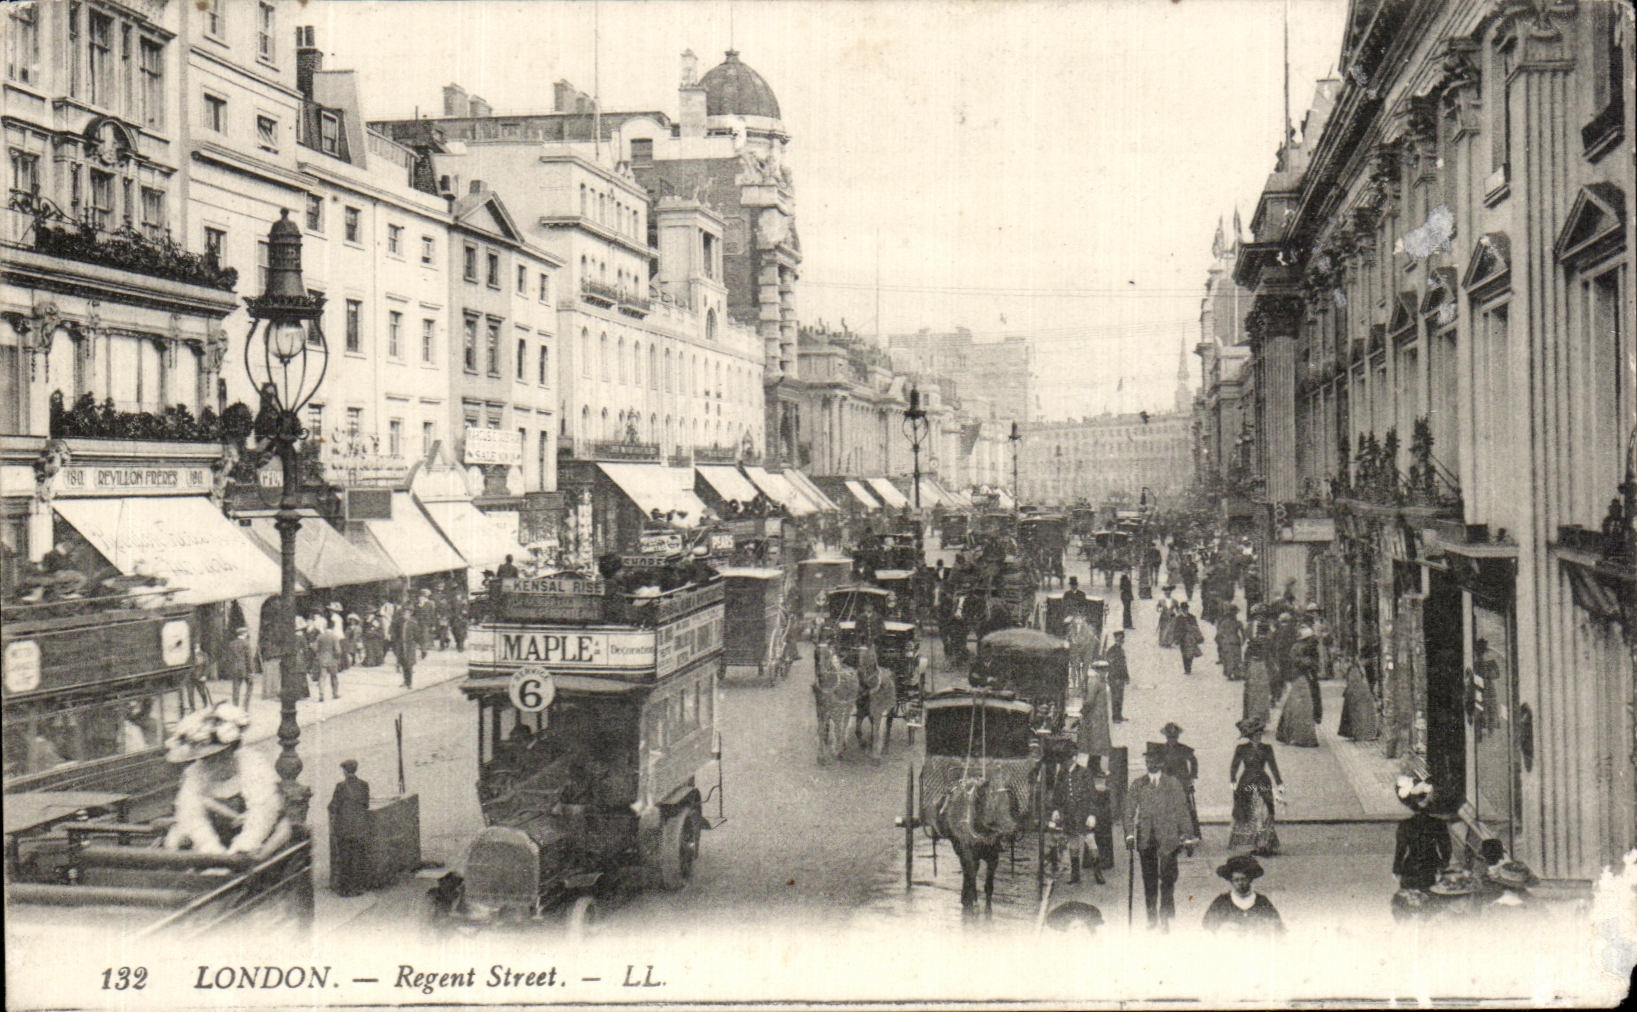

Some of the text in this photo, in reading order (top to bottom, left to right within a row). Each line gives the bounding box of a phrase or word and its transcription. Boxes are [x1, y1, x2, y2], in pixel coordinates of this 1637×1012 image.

[97, 470, 143, 486] REVILLON
[513, 579, 602, 593] KENSAL RISE
[501, 634, 594, 663] MAPLE
[519, 679, 543, 708] 6
